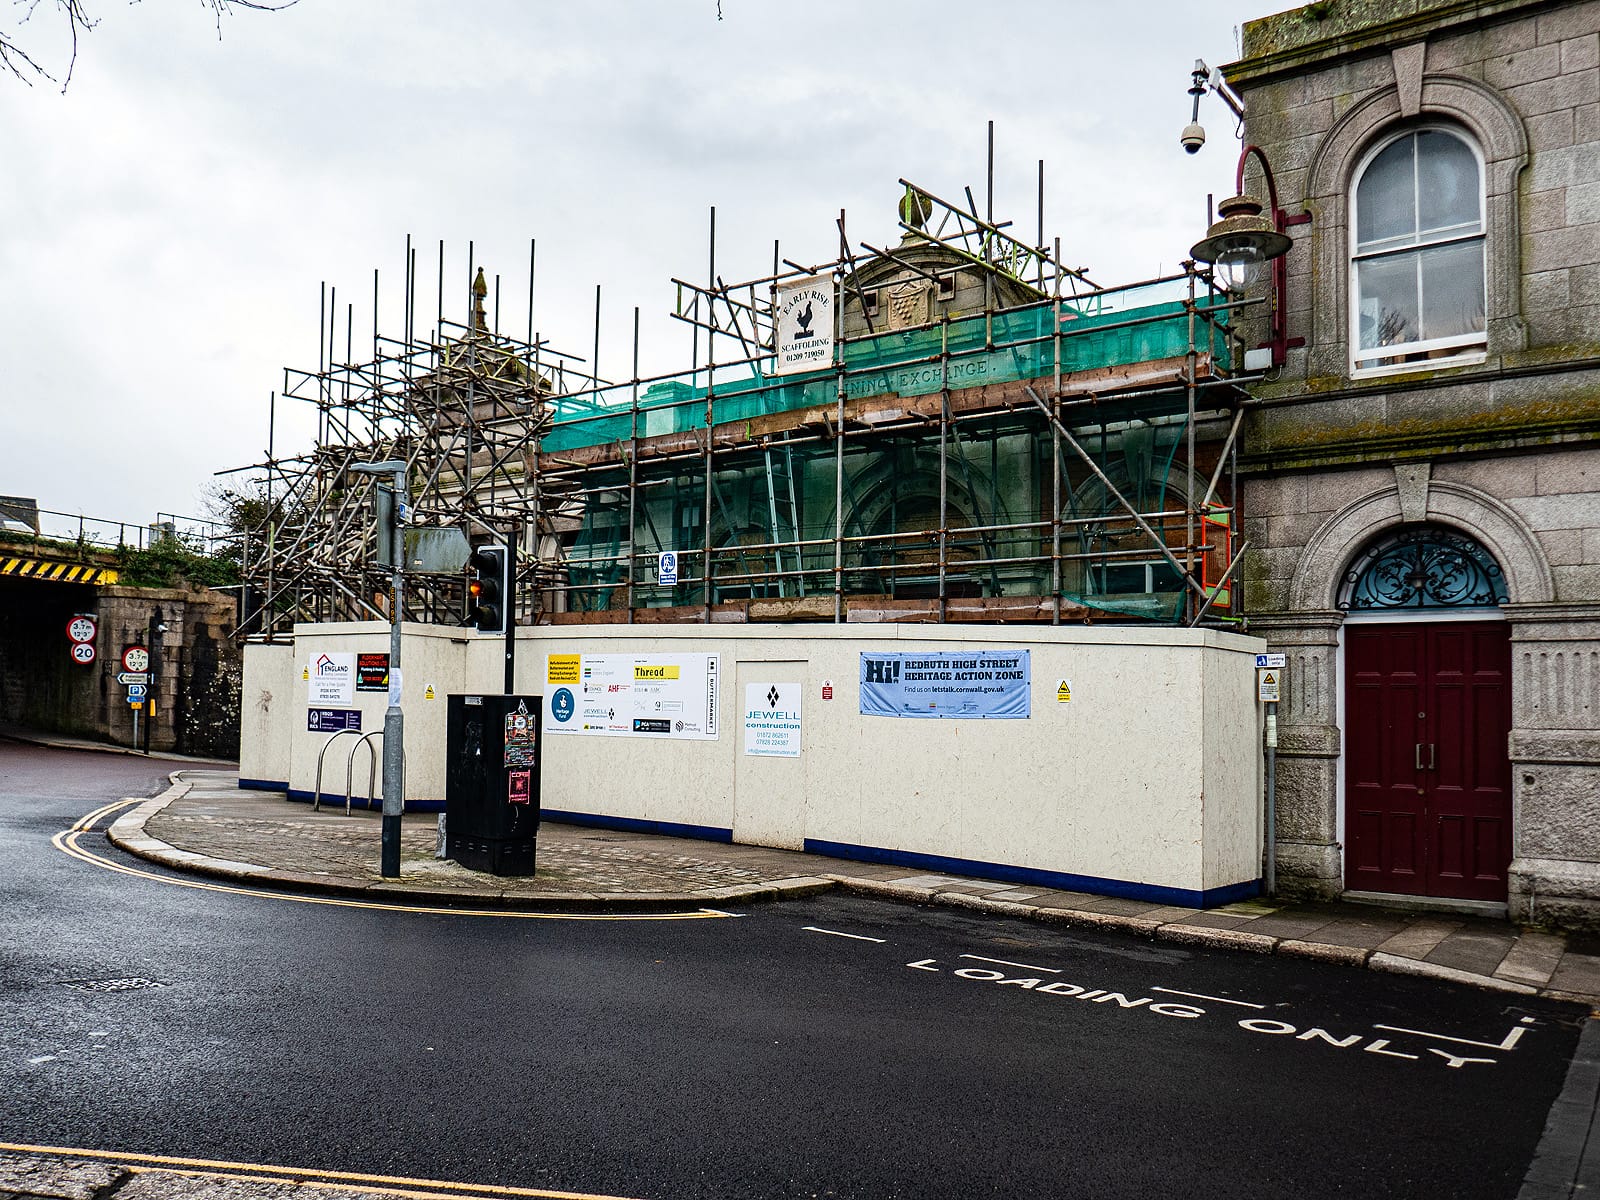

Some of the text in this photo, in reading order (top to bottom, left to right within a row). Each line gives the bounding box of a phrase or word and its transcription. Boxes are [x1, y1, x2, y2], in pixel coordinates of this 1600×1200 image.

[783, 290, 830, 316] EARLY RISE
[781, 336, 830, 353] SCAFFOLDING
[786, 349, 825, 362] 01209 719050
[76, 648, 93, 658] 20
[904, 659, 1019, 670] REDRUTH HIGH STREET
[635, 667, 664, 677] Thread
[865, 660, 901, 684] Hi!
[904, 670, 1024, 681] HERITAGE ACTION ZONE
[132, 686, 138, 694] P
[931, 685, 1005, 694] letstalk.cornwall.gov.uk
[745, 711, 801, 720] JEWELL
[906, 958, 1498, 1068] LOADING ONLY
